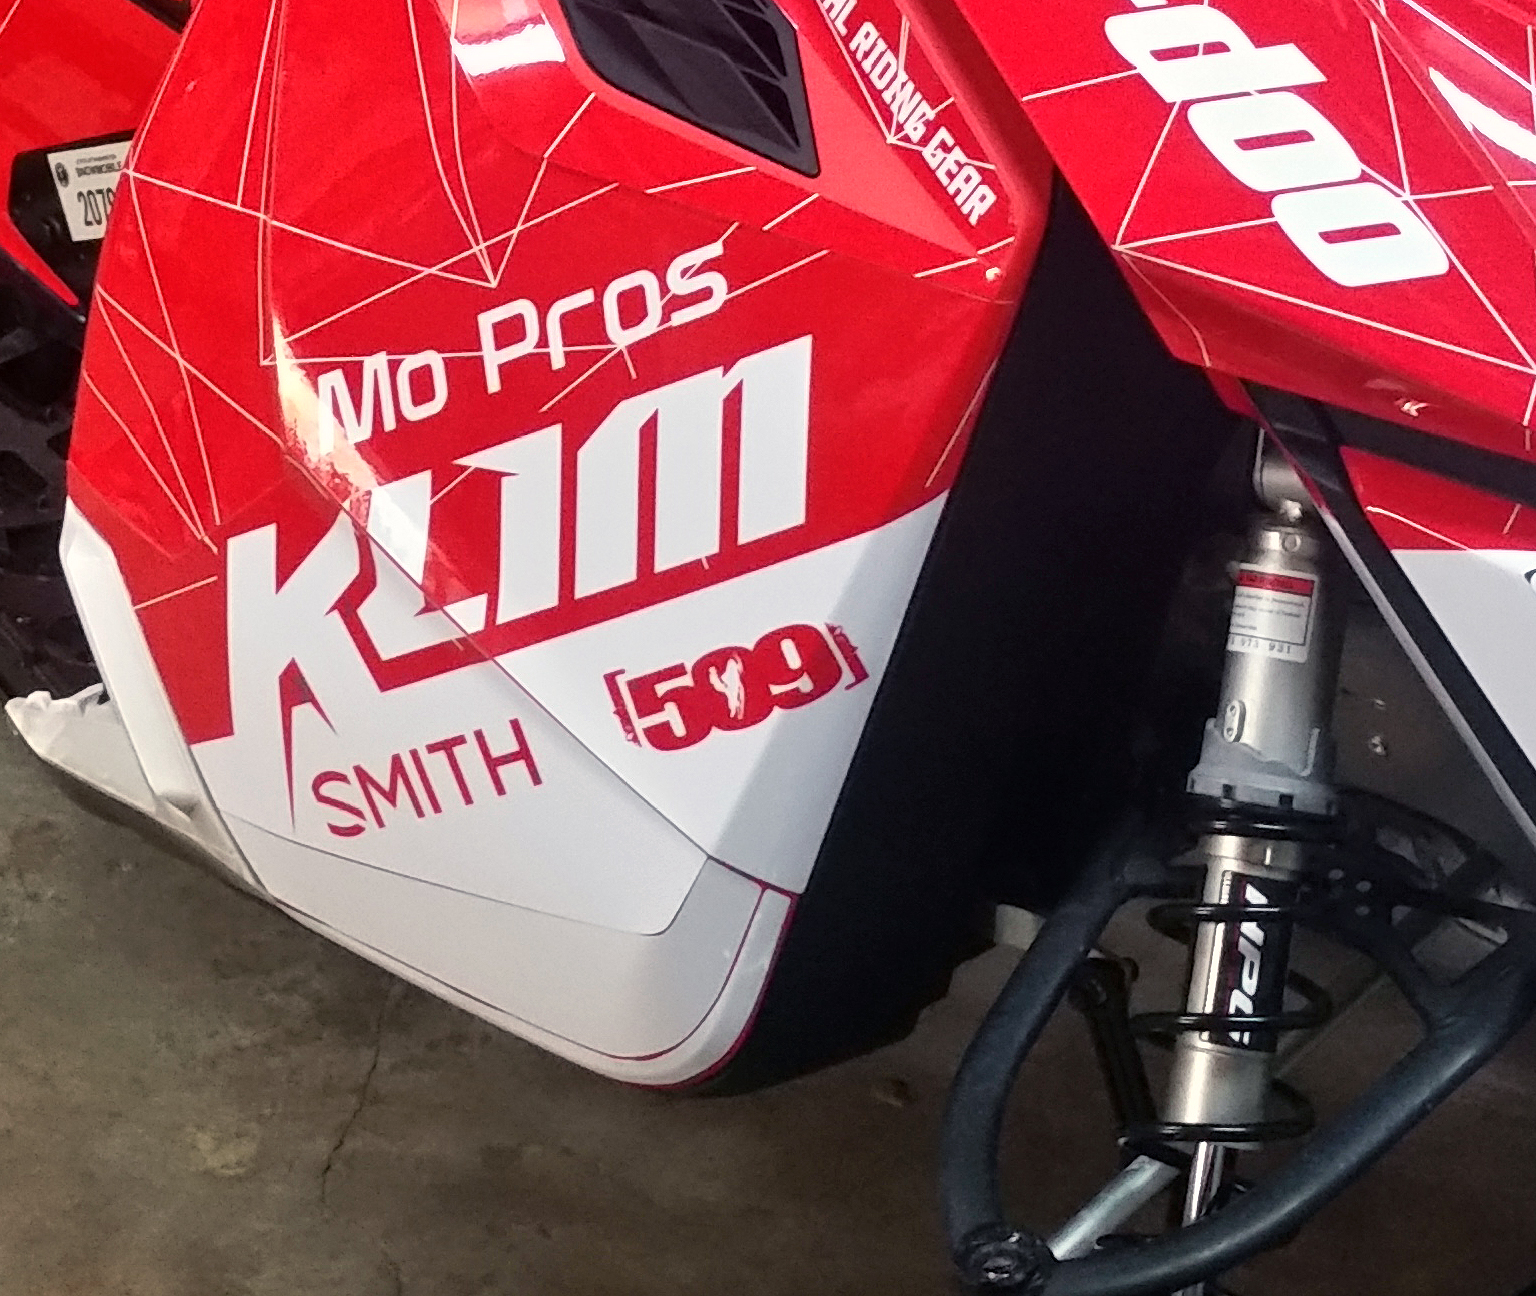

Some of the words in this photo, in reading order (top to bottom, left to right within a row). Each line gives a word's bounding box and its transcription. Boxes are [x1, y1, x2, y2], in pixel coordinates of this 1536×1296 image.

[849, 21, 934, 144] RIDING
[921, 125, 998, 226] GEAR
[476, 240, 729, 393] Pros
[311, 716, 545, 837] SMITH
